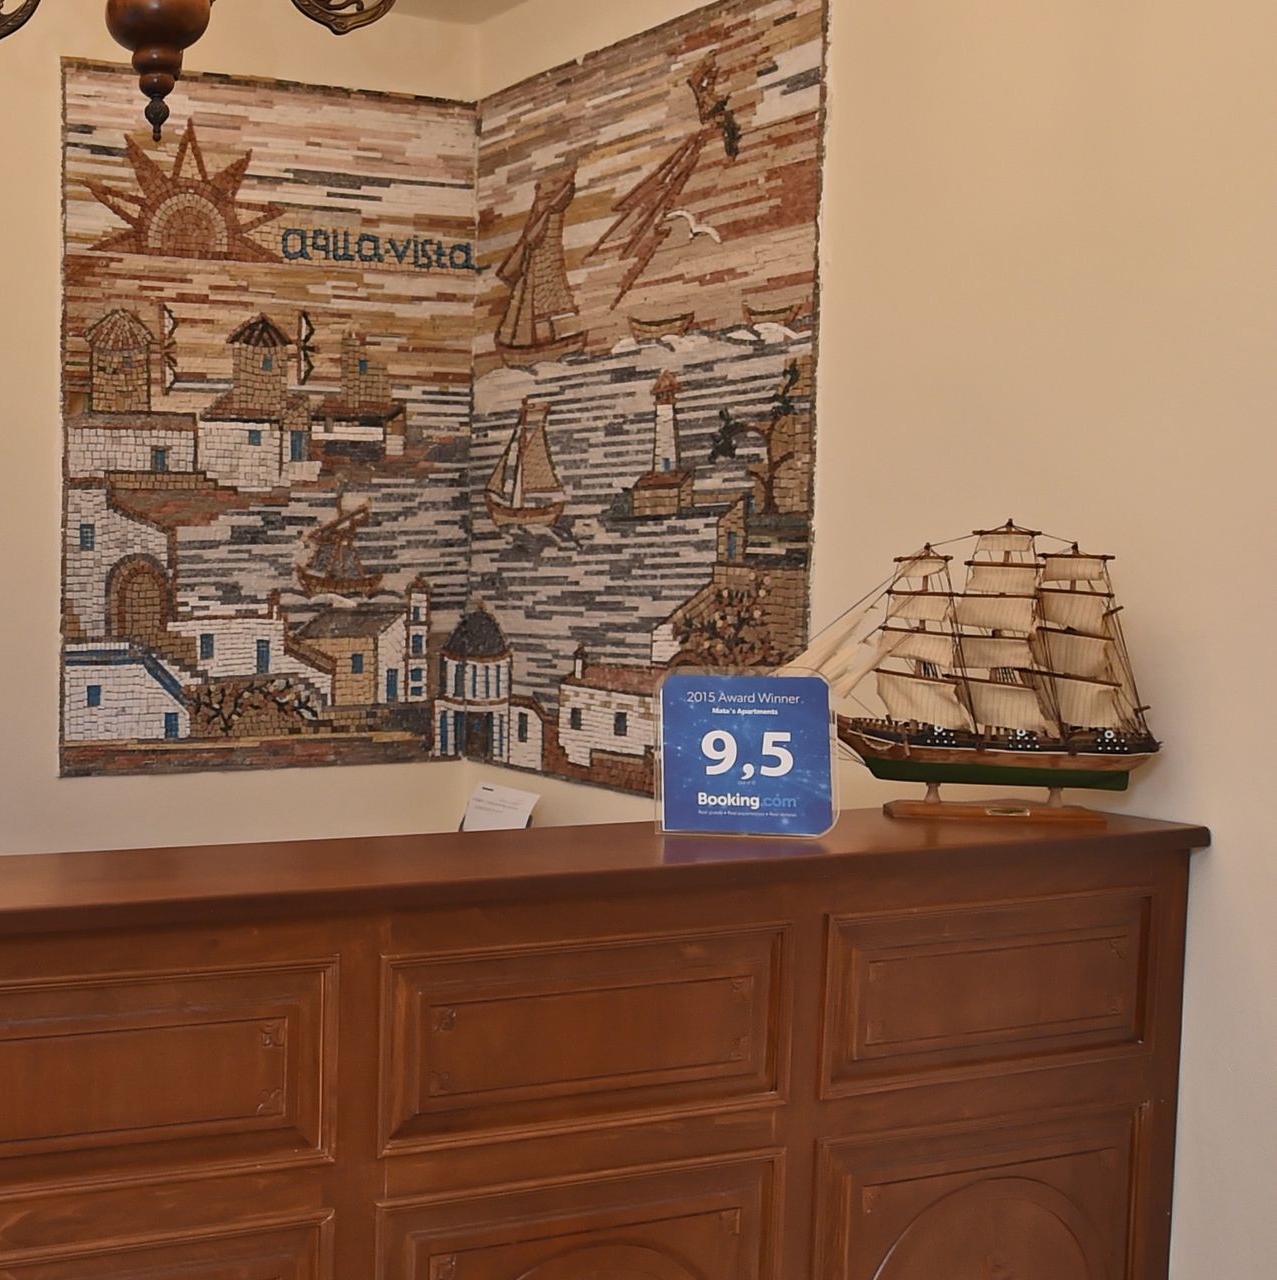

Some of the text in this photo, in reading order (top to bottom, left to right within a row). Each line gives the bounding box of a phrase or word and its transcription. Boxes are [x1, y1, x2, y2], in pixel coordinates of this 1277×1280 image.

[686, 691, 801, 705] 2015 Award Winner
[737, 707, 778, 716] Apartments
[700, 729, 795, 780] 9,5
